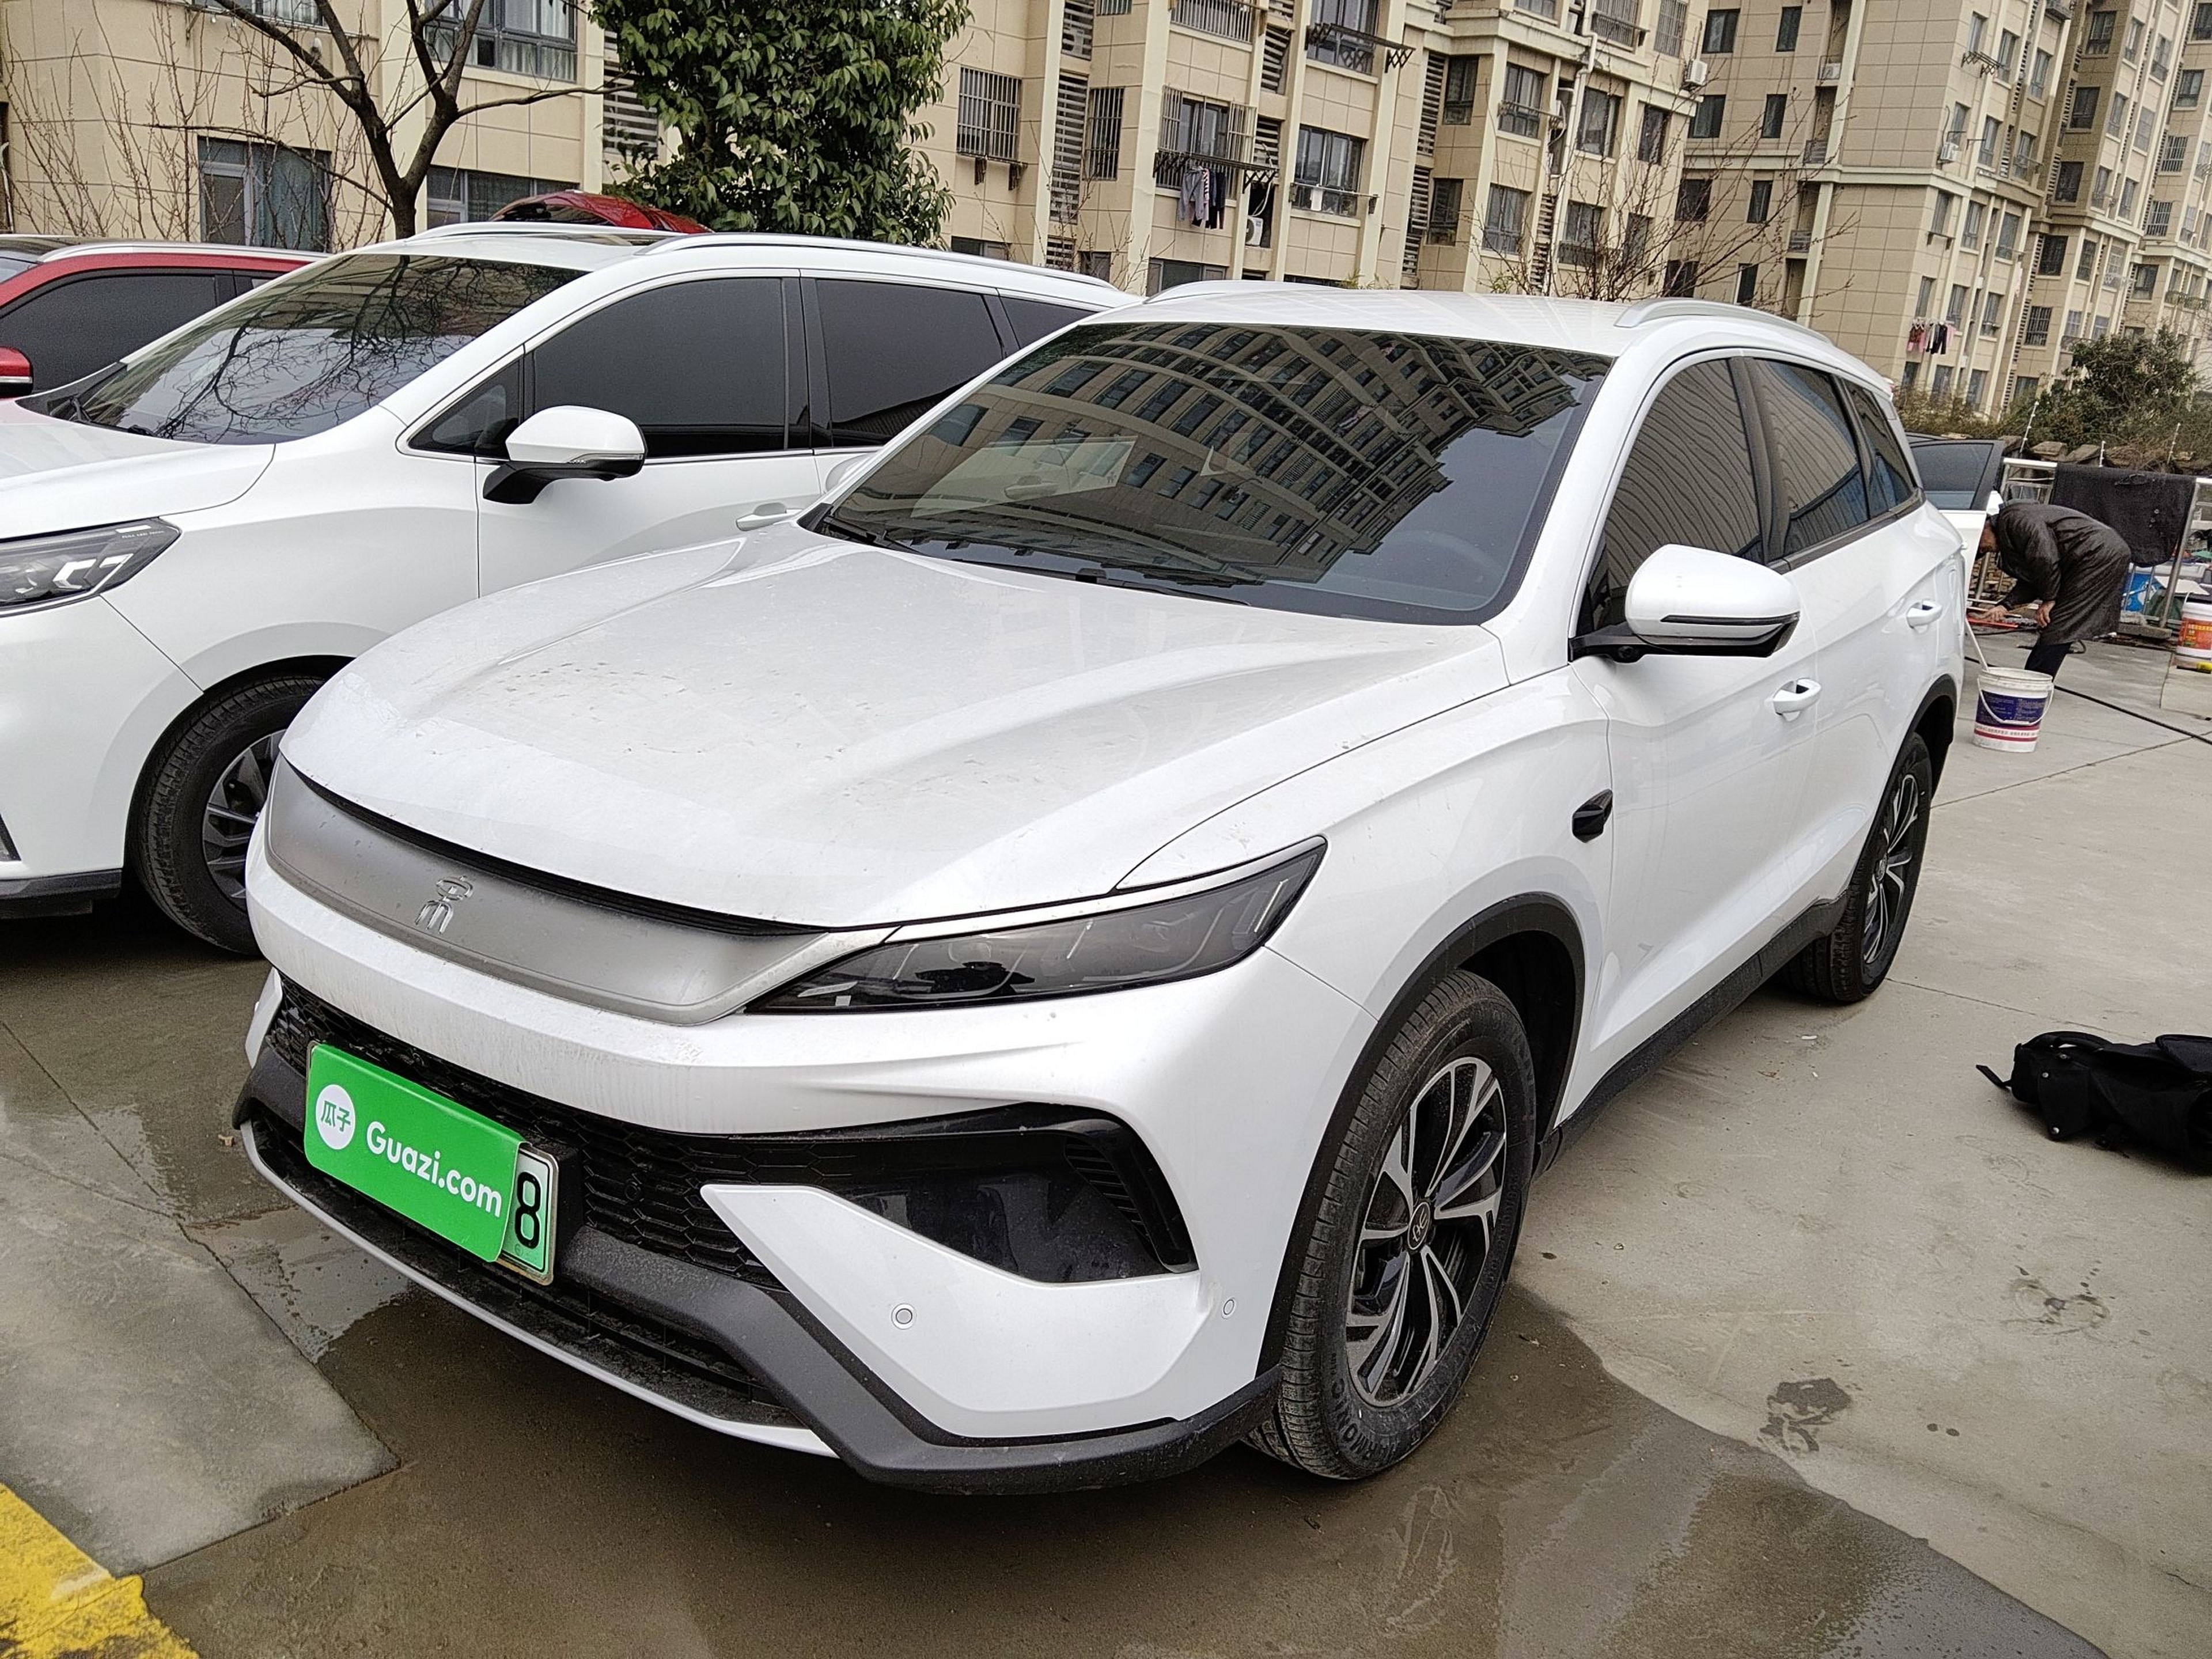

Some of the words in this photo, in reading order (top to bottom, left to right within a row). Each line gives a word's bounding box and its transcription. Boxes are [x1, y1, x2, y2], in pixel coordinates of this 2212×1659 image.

[320, 1100, 351, 1132] 瓜子
[366, 1120, 502, 1218] Guazi.com
[514, 1171, 541, 1249] 8
